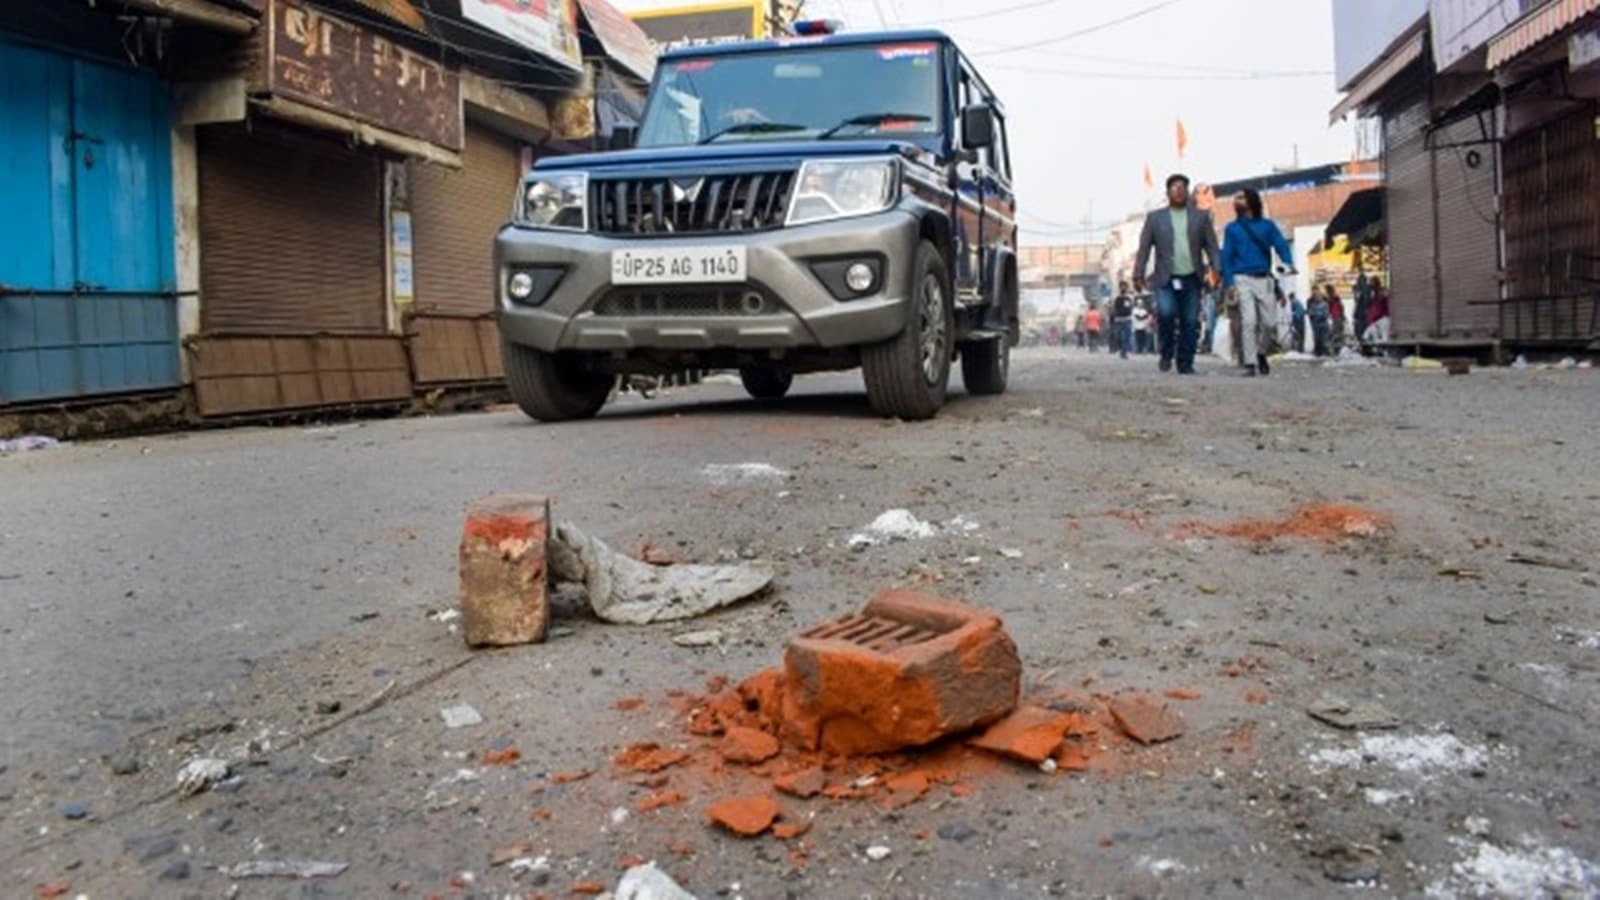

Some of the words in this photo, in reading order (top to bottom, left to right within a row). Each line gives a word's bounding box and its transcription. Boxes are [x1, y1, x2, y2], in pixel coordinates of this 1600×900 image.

[623, 258, 665, 277] UP25
[671, 257, 692, 275] AG
[701, 256, 738, 275] 1140
